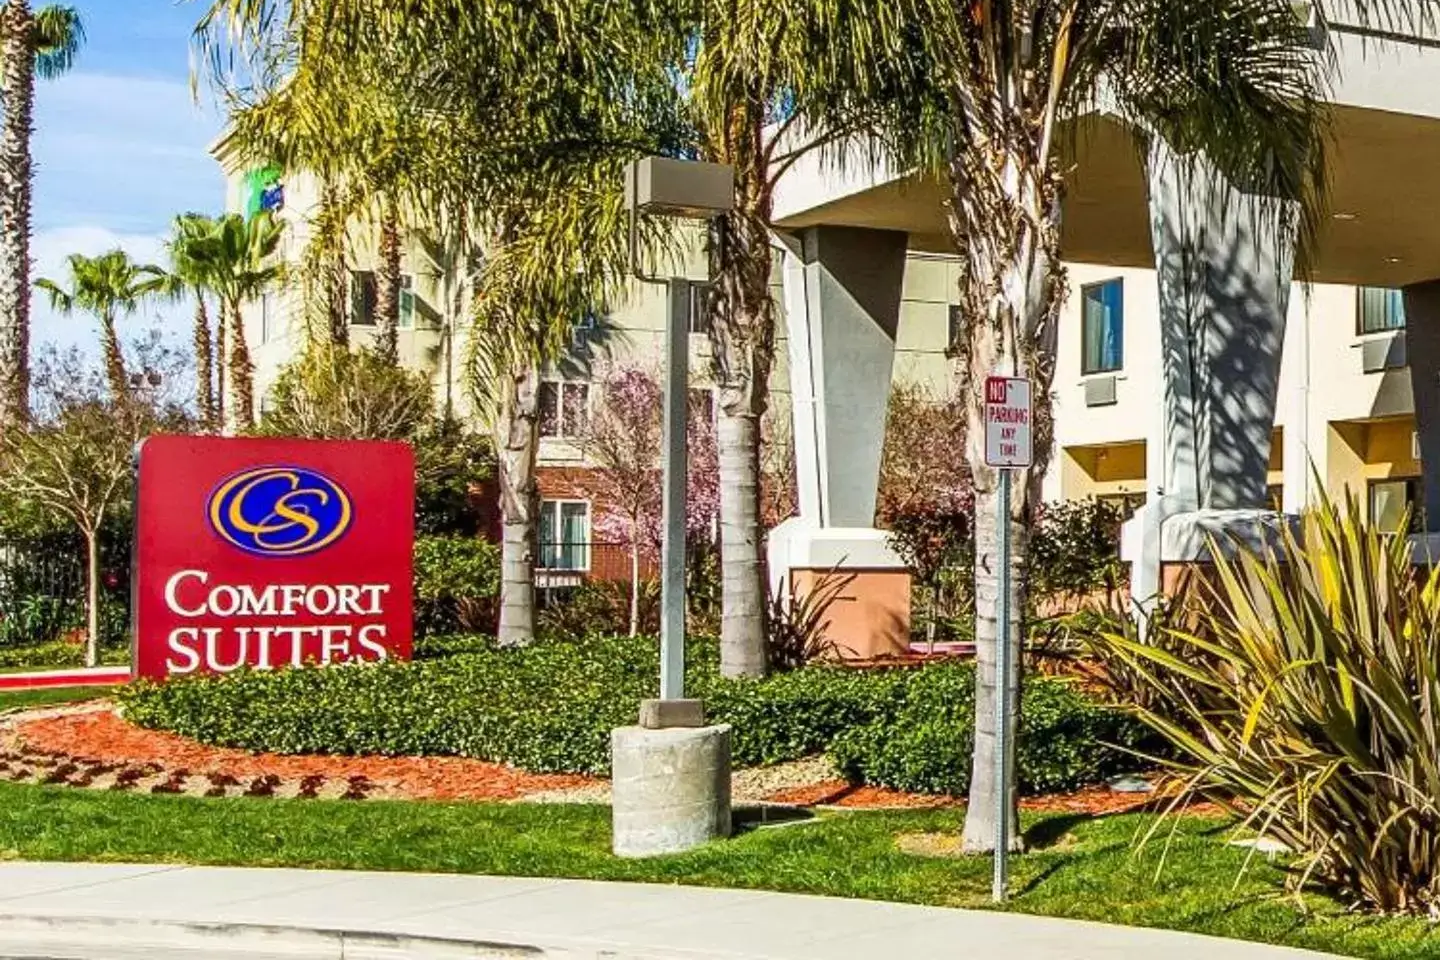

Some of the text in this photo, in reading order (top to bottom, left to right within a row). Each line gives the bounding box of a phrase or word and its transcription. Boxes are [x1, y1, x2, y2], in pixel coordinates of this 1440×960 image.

[989, 382, 1005, 400] NO
[989, 407, 1028, 424] PARKING
[1001, 428, 1016, 439] ANY
[1000, 444, 1016, 456] TIME
[164, 569, 391, 617] COMFORT
[165, 623, 389, 674] SUITES
